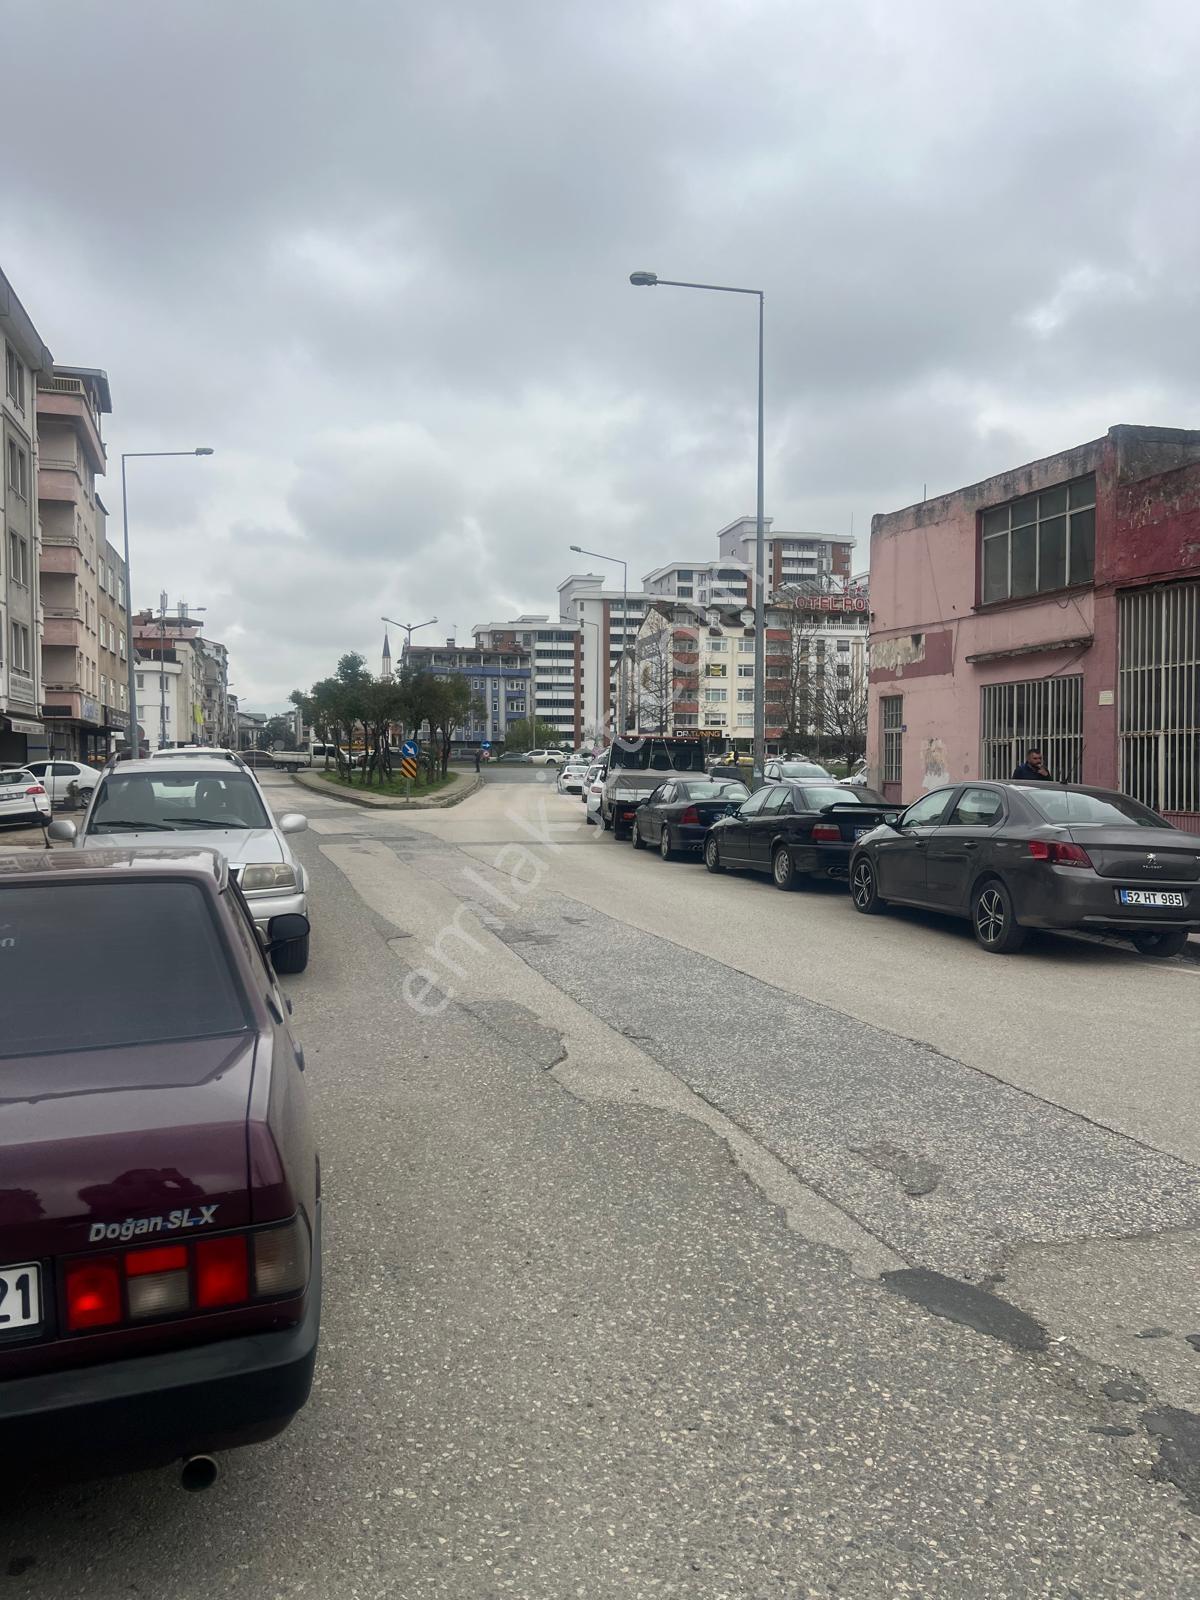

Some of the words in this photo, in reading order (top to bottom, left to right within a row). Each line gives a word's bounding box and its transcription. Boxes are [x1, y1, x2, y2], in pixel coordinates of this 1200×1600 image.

[795, 595, 840, 610] OTEL
[843, 597, 869, 611] RO
[1127, 891, 1141, 903] 52
[1144, 892, 1157, 904] HT
[1161, 893, 1181, 905] 985
[89, 1217, 163, 1242] Doğan
[167, 1204, 220, 1230] SLX
